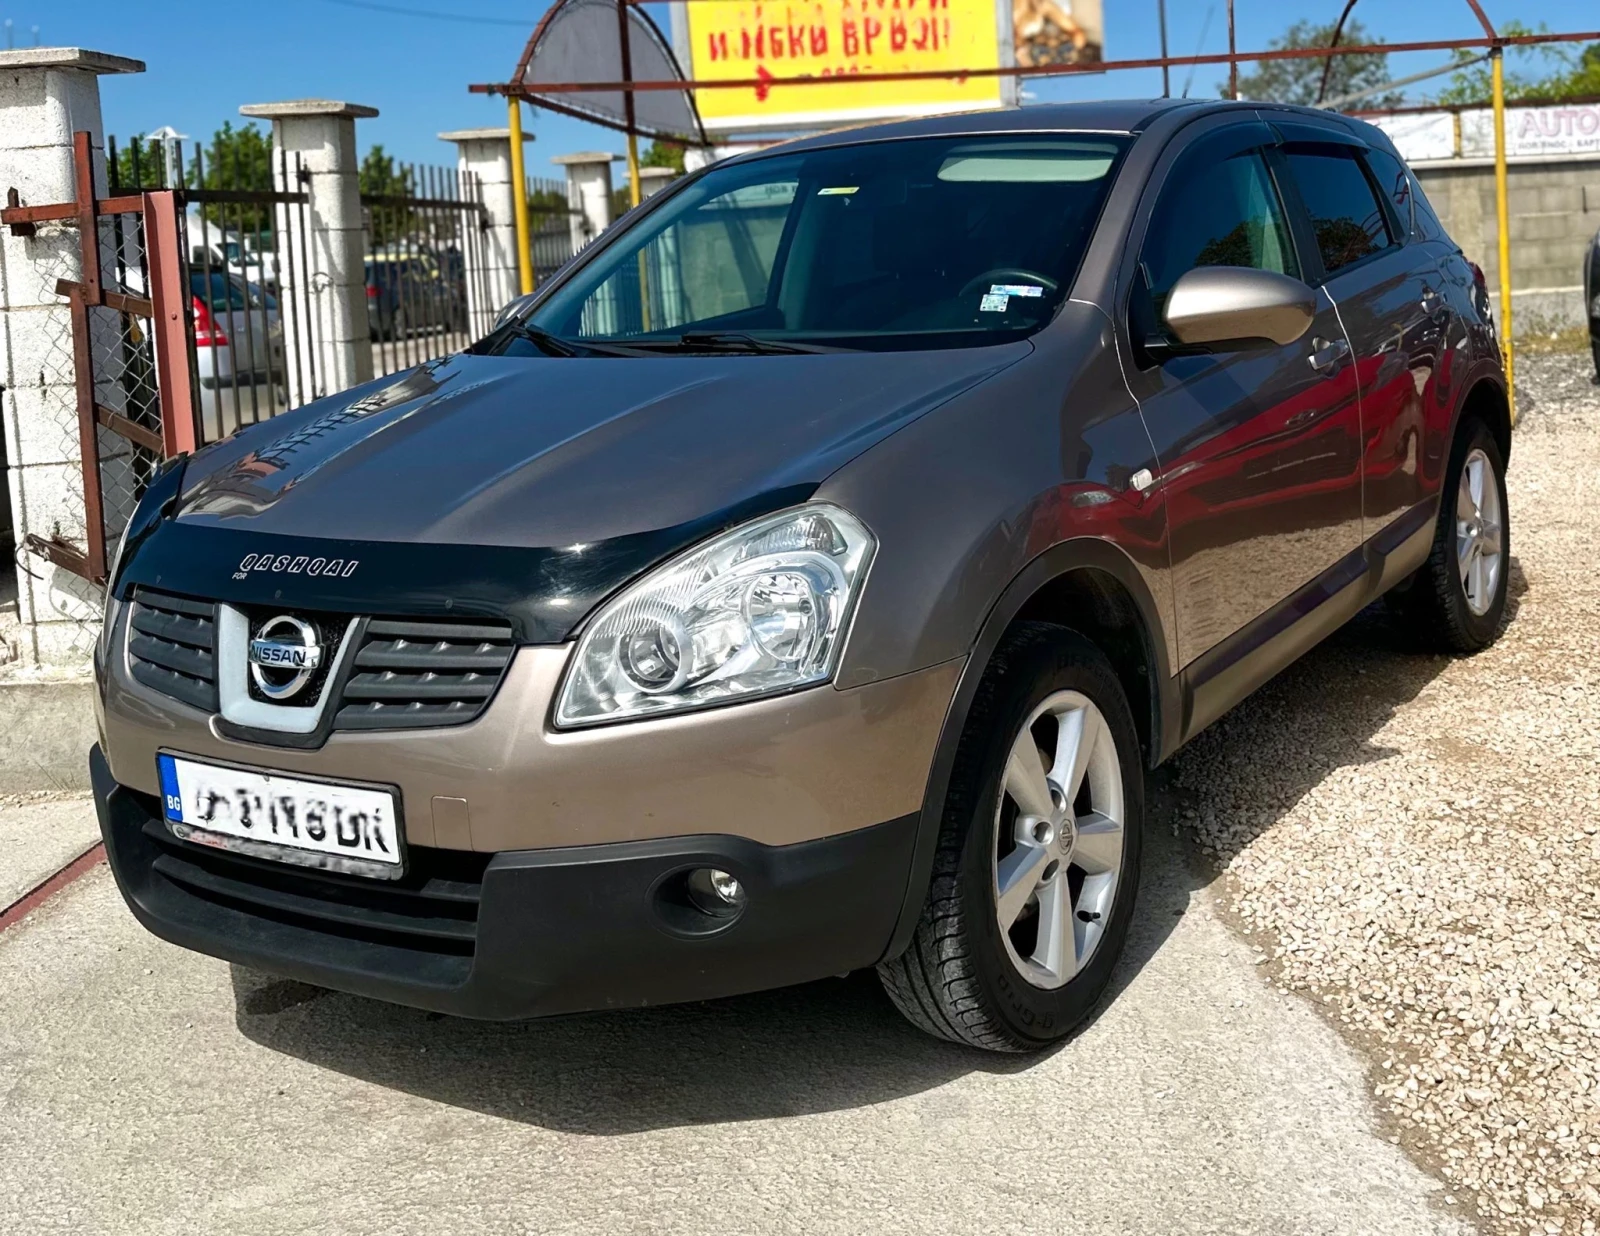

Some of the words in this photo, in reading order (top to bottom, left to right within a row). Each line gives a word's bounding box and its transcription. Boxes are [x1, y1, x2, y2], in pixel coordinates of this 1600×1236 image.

[1518, 109, 1600, 139] AUTO
[239, 553, 359, 577] QASHQAI
[232, 572, 247, 580] FOR
[251, 643, 307, 664] NISSAN
[166, 794, 181, 811] BG
